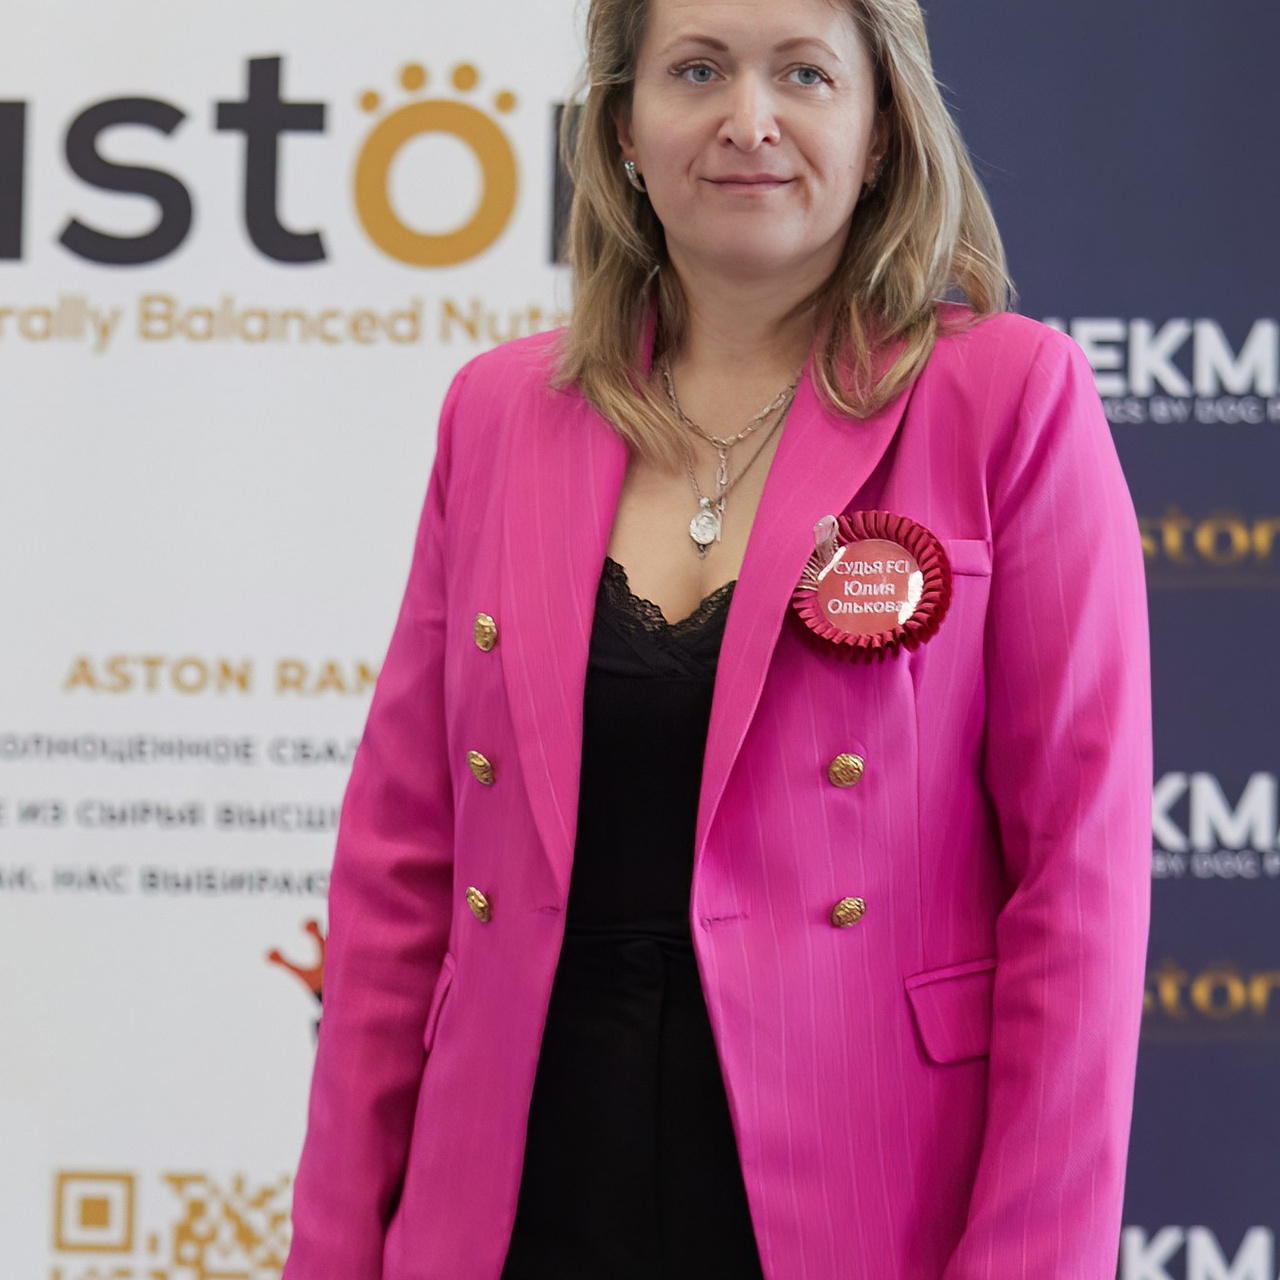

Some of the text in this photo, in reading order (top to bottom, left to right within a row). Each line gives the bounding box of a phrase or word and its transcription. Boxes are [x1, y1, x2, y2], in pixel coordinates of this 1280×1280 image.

[138, 296, 422, 345] Balanced
[440, 297, 570, 343] Nut
[1042, 317, 1280, 398] EKM
[886, 560, 910, 574] FCI
[65, 655, 253, 694] ASTON
[215, 803, 339, 833] ВЫСШ
[1151, 771, 1280, 852] KM
